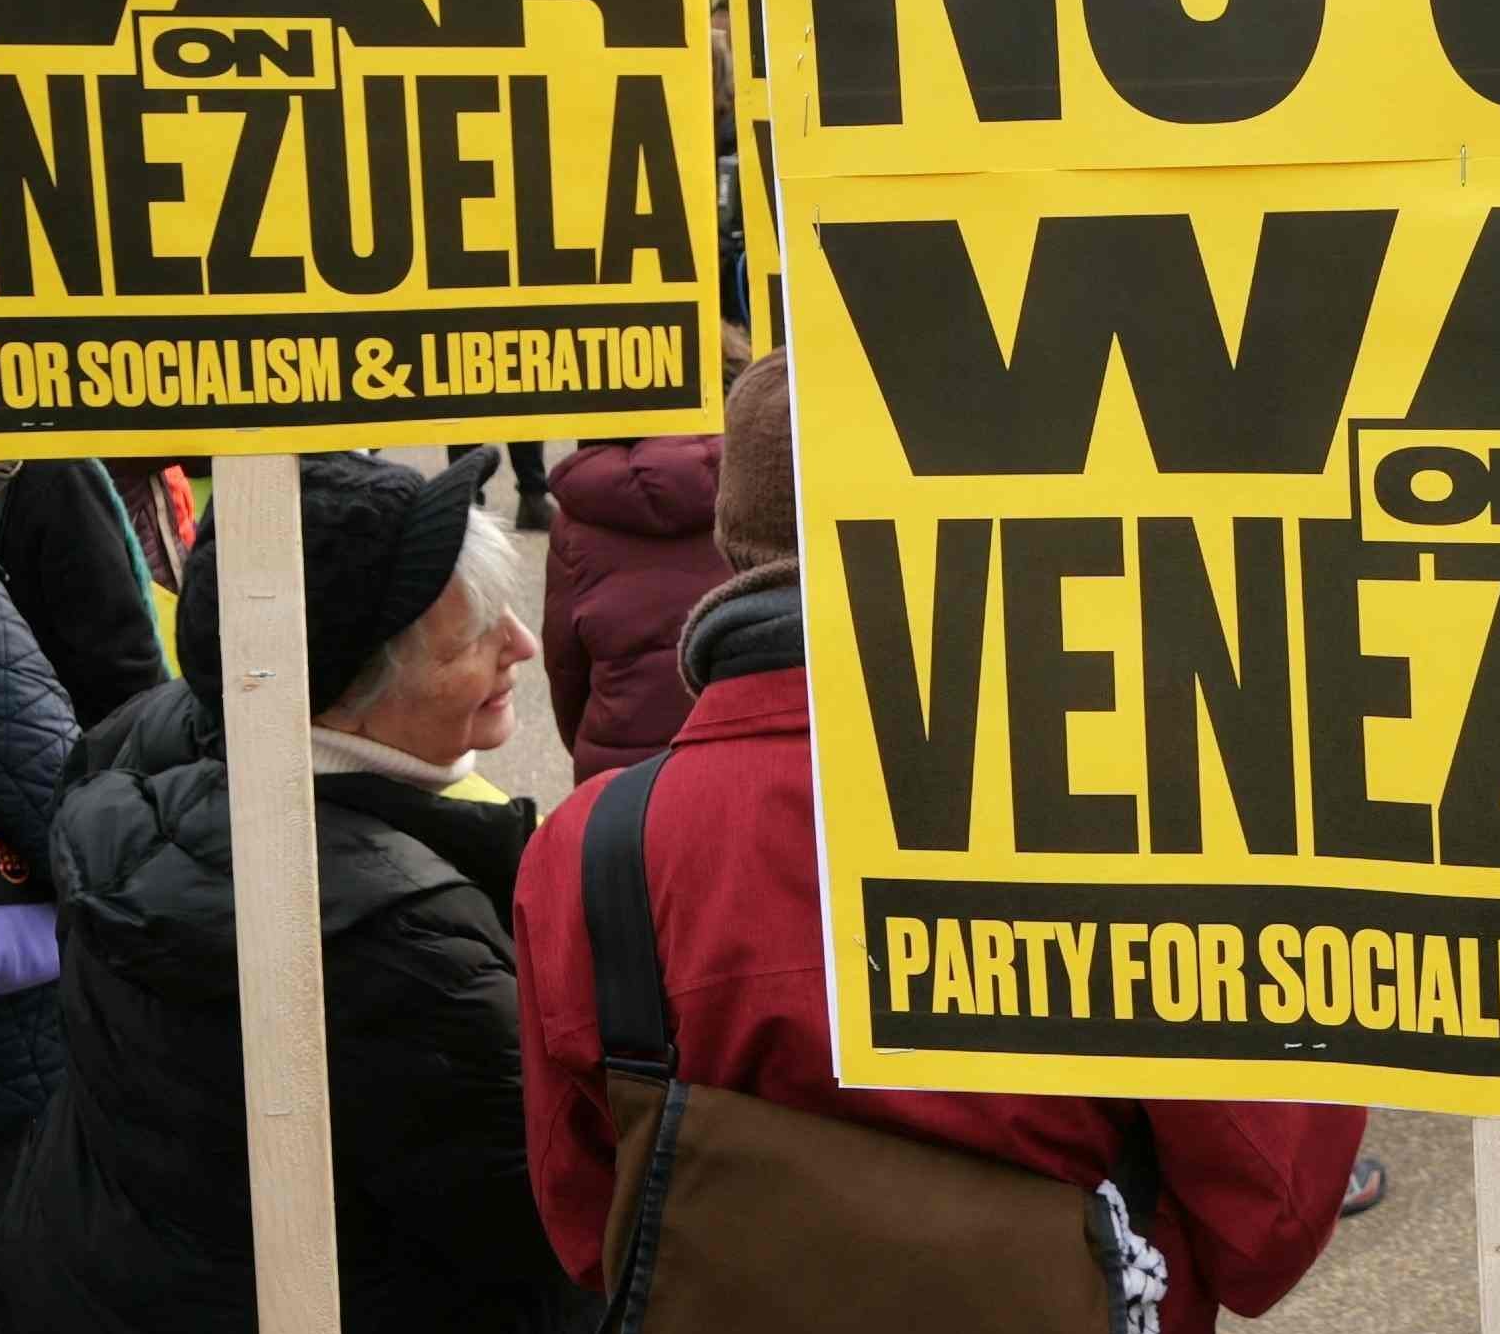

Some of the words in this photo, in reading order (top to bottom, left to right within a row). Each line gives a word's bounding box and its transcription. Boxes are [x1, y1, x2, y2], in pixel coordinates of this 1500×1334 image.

[153, 28, 314, 78] ON
[78, 338, 341, 407] SOCIALISM
[352, 338, 415, 399] &
[421, 326, 683, 396] LIBERATION
[886, 917, 1097, 1018] PARTY
[1110, 923, 1247, 1022] FOR
